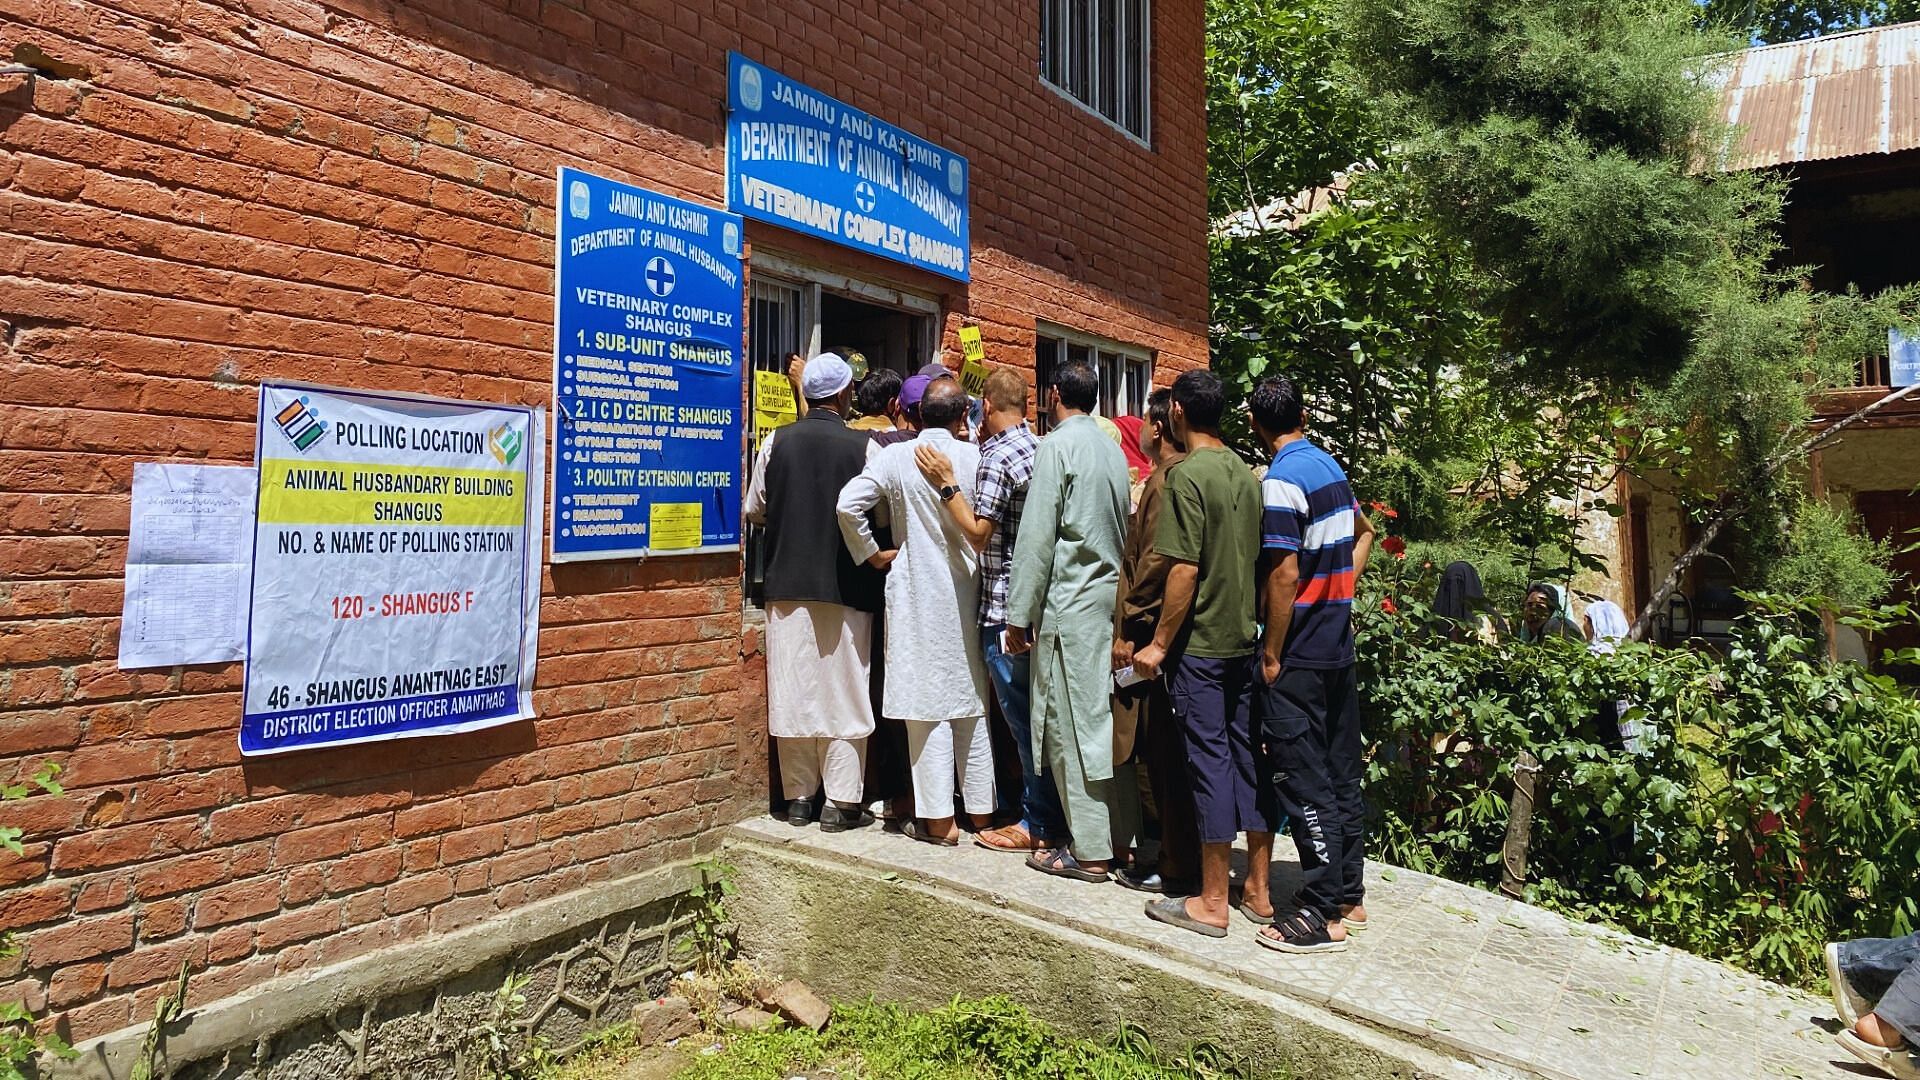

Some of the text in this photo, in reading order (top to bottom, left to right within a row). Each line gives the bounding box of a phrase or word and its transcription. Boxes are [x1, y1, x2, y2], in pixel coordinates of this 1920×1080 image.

[772, 81, 942, 171] JAMMU AND KASHMIR
[741, 122, 962, 238] DEPARTMENT OF ANIMAL HUSBANDRY
[609, 190, 709, 237] JAMMU AND KASHMIR
[741, 174, 964, 273] VETERINARY COMPLEX SHANGUS
[570, 228, 737, 289] DEPARTMENT OF ANIMAL HUSBANDRY
[576, 287, 733, 327] VETERINARY COMPLEX
[625, 314, 692, 338] SHANGUS
[577, 329, 732, 366] 1. SUB-UNIT SHANGUS
[577, 355, 673, 376] MEDICAL SECTION
[576, 370, 679, 391] SURGICAL SECTION
[761, 384, 770, 394] YOU
[771, 385, 779, 396] ARE
[576, 385, 649, 402] VACCINATION
[575, 400, 732, 425] 2. I C D CENTRE SHANGUS
[336, 422, 407, 450] POLLING
[412, 428, 484, 454] LOCATION
[575, 420, 723, 440] UPGRADATION OF LIVESTOCK
[574, 437, 662, 450] GYNAE SECTION
[592, 452, 640, 464] SECTION
[284, 469, 514, 497] ANIMAL HUSBANDARY BUILDING
[573, 468, 731, 488] 3. POULTRY EXTENSION CENTRE
[374, 501, 443, 522] SHANGUS
[573, 494, 640, 505] TREATMENT
[572, 509, 623, 522] REARING
[572, 523, 646, 537] VACCINATION
[278, 531, 514, 555] NO. & NAME OF POLLING STATION
[331, 595, 363, 619] 120
[381, 591, 460, 617] SHANGUS
[466, 591, 474, 613] F
[267, 685, 290, 710] 46
[305, 676, 387, 706] SHANGUS
[391, 667, 471, 697] ANANTNAG
[475, 664, 507, 687] EAST
[263, 690, 505, 739] DISTRICT ELECTION OFFICER ANANTNAG
[1303, 801, 1330, 865] AIRMAX
